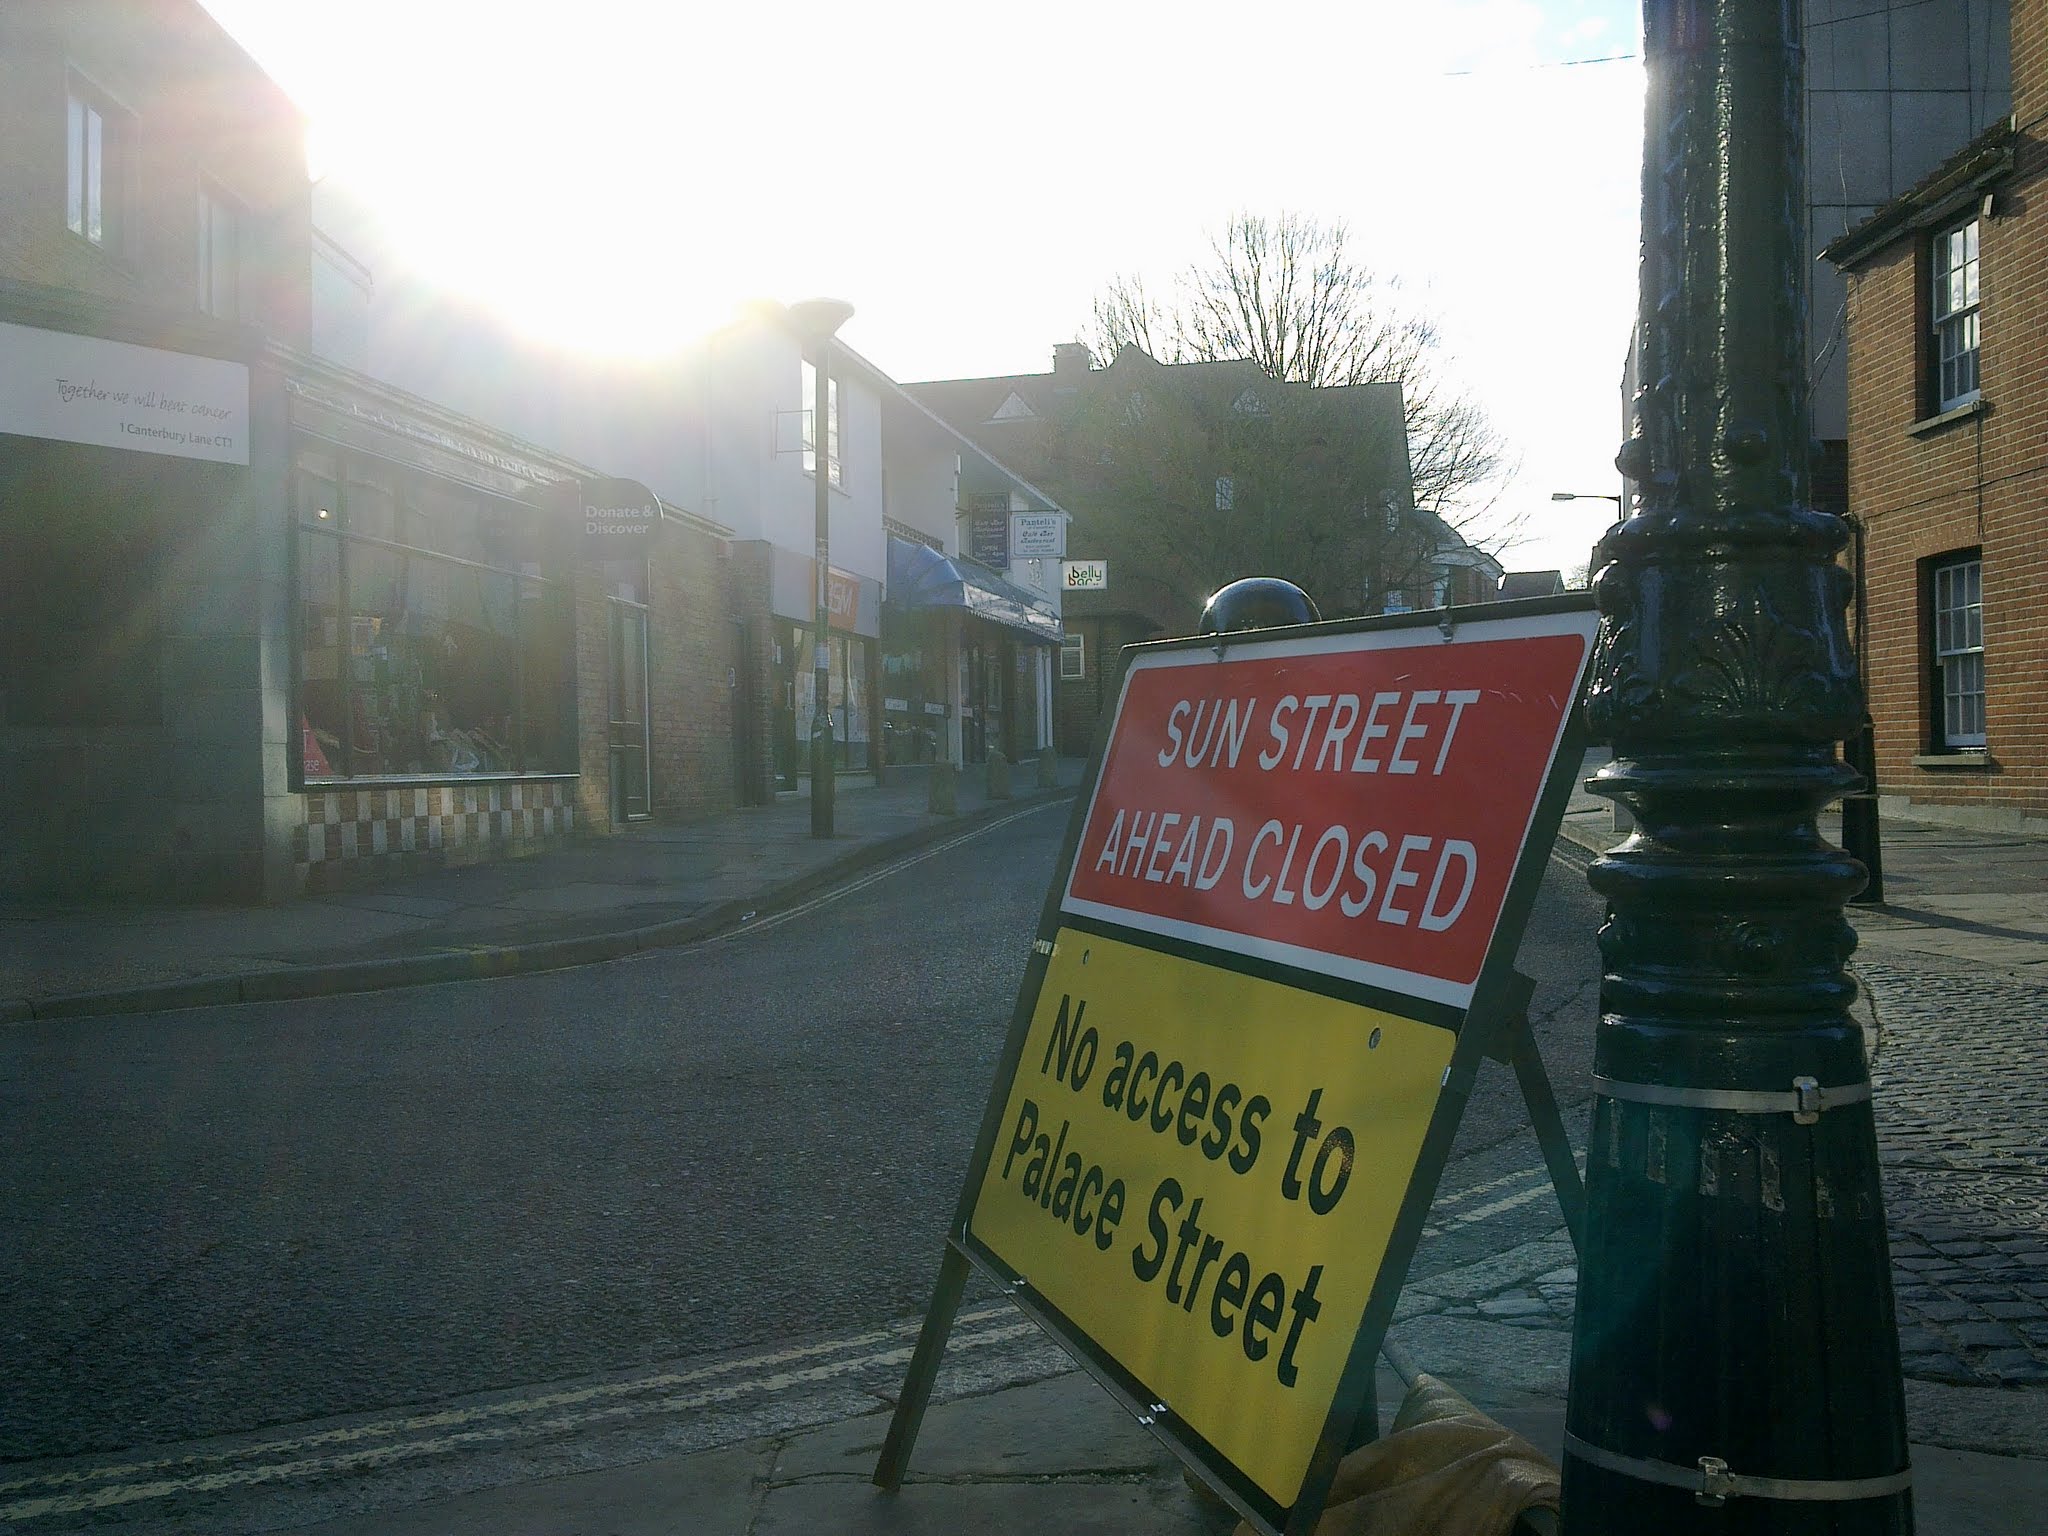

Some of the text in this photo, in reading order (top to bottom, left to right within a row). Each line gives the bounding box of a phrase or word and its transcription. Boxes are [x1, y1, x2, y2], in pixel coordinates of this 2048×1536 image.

[56, 378, 232, 420] Together we will beat cancer
[119, 422, 233, 448] 1 Canterbury Lane CT1
[585, 505, 655, 518] Donate &
[585, 522, 649, 535] Discover
[1068, 573, 1093, 586] bar
[1072, 565, 1102, 582] belly
[1158, 689, 1481, 776] SUN STREET
[1094, 808, 1478, 932] AHEAD CLOSED
[1041, 994, 1355, 1216] No access to
[1002, 1098, 1325, 1388] Palace Street
